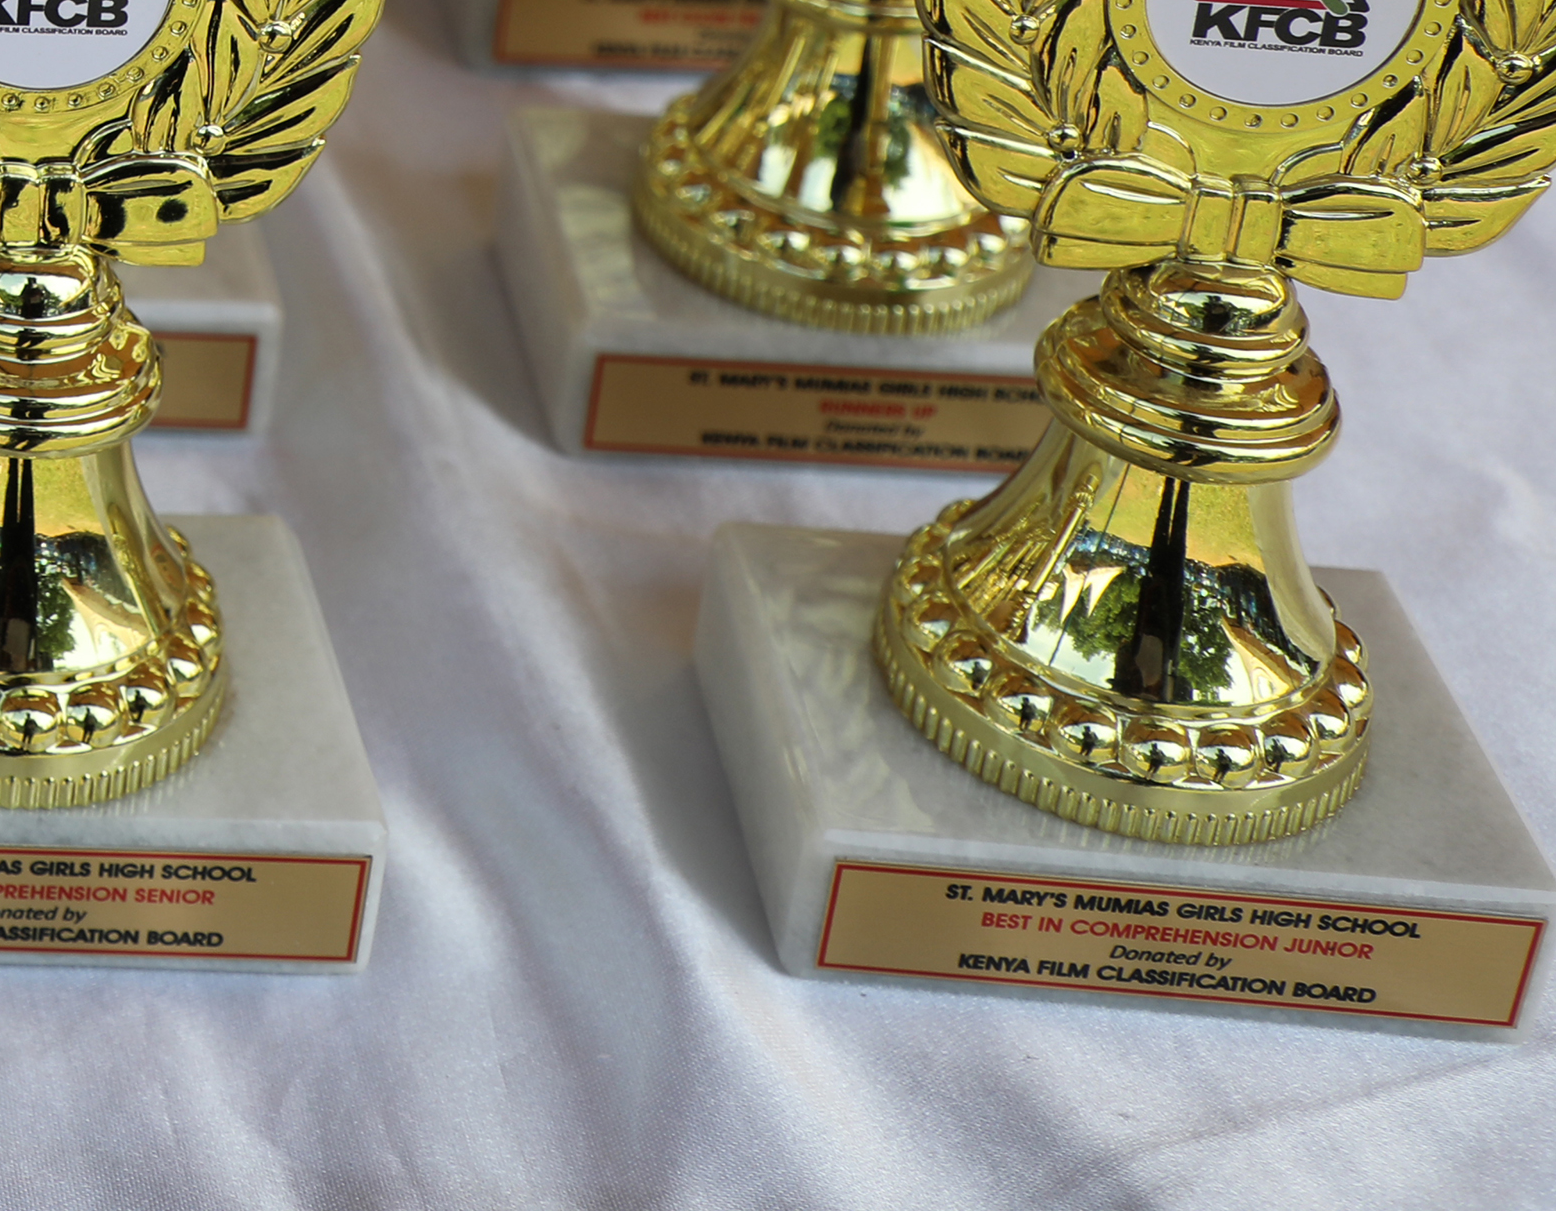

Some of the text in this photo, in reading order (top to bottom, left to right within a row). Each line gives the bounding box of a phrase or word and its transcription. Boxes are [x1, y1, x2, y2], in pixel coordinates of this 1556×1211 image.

[22, 27, 93, 35] CLASSIFICATION
[1192, 2, 1368, 48] KFCB
[1190, 39, 1221, 47] KENYA
[1248, 43, 1325, 54] CLASSIFICATION
[1327, 48, 1363, 57] BOARD
[29, 859, 92, 878] GIRLS
[97, 862, 155, 880] HIGH
[161, 863, 257, 882] SCHOOL
[133, 886, 215, 905] SENIOR
[60, 907, 86, 925] by
[945, 883, 1421, 939] ST. MARY'S MUMIAS GIRLS HIGH SCHOOL
[147, 928, 224, 947] BOARD
[981, 911, 1374, 960] BEST IN COMPREHENSION JUNIOR
[1109, 943, 1232, 971] Donated by
[958, 953, 1376, 1004] KENYA FILM CLASSIFICATION BOARD
